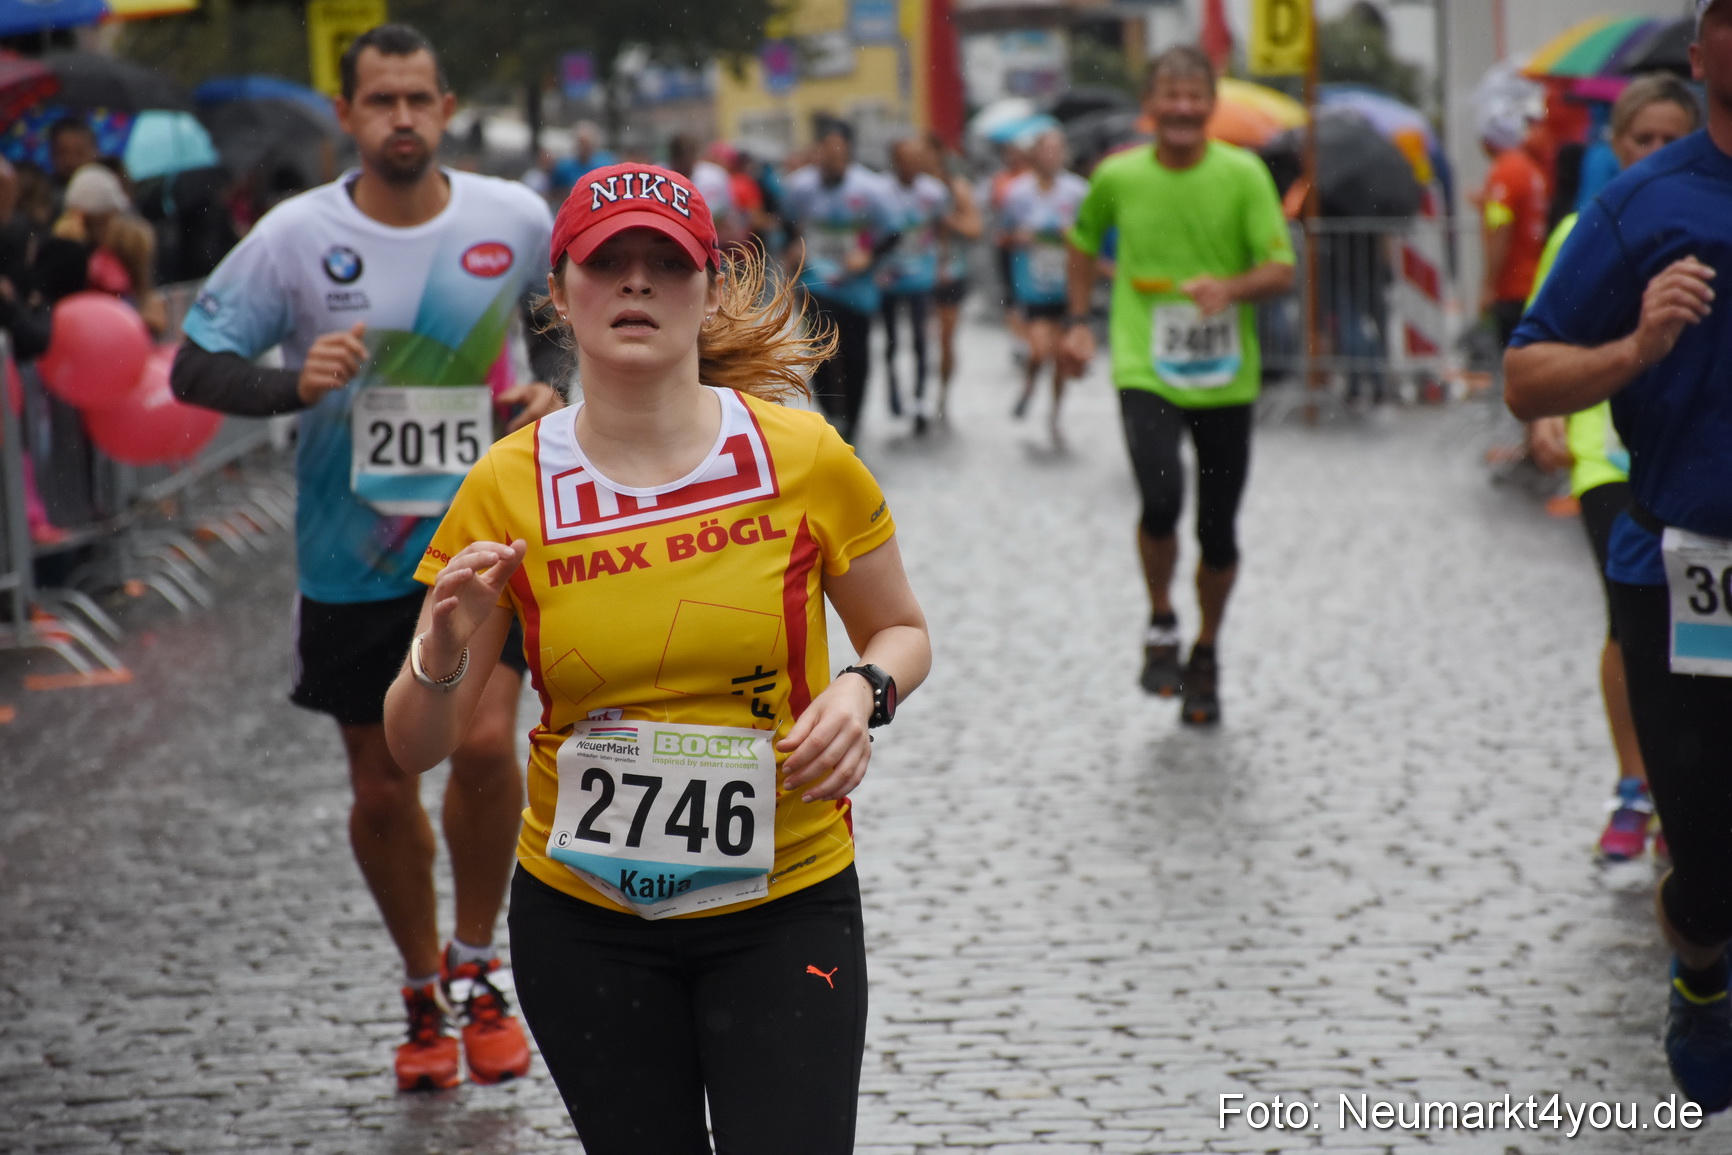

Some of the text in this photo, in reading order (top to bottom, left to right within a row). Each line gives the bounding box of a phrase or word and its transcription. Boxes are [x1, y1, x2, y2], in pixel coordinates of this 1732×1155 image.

[590, 172, 692, 220] NIKE
[369, 419, 480, 467] 2015
[546, 514, 788, 588] MAX BÖGL
[576, 741, 640, 756] NeuerMarkt
[652, 756, 759, 770] inspired by smart concepts
[653, 730, 758, 760] BOCK
[575, 767, 756, 857] 2746
[620, 869, 692, 899] Katja
